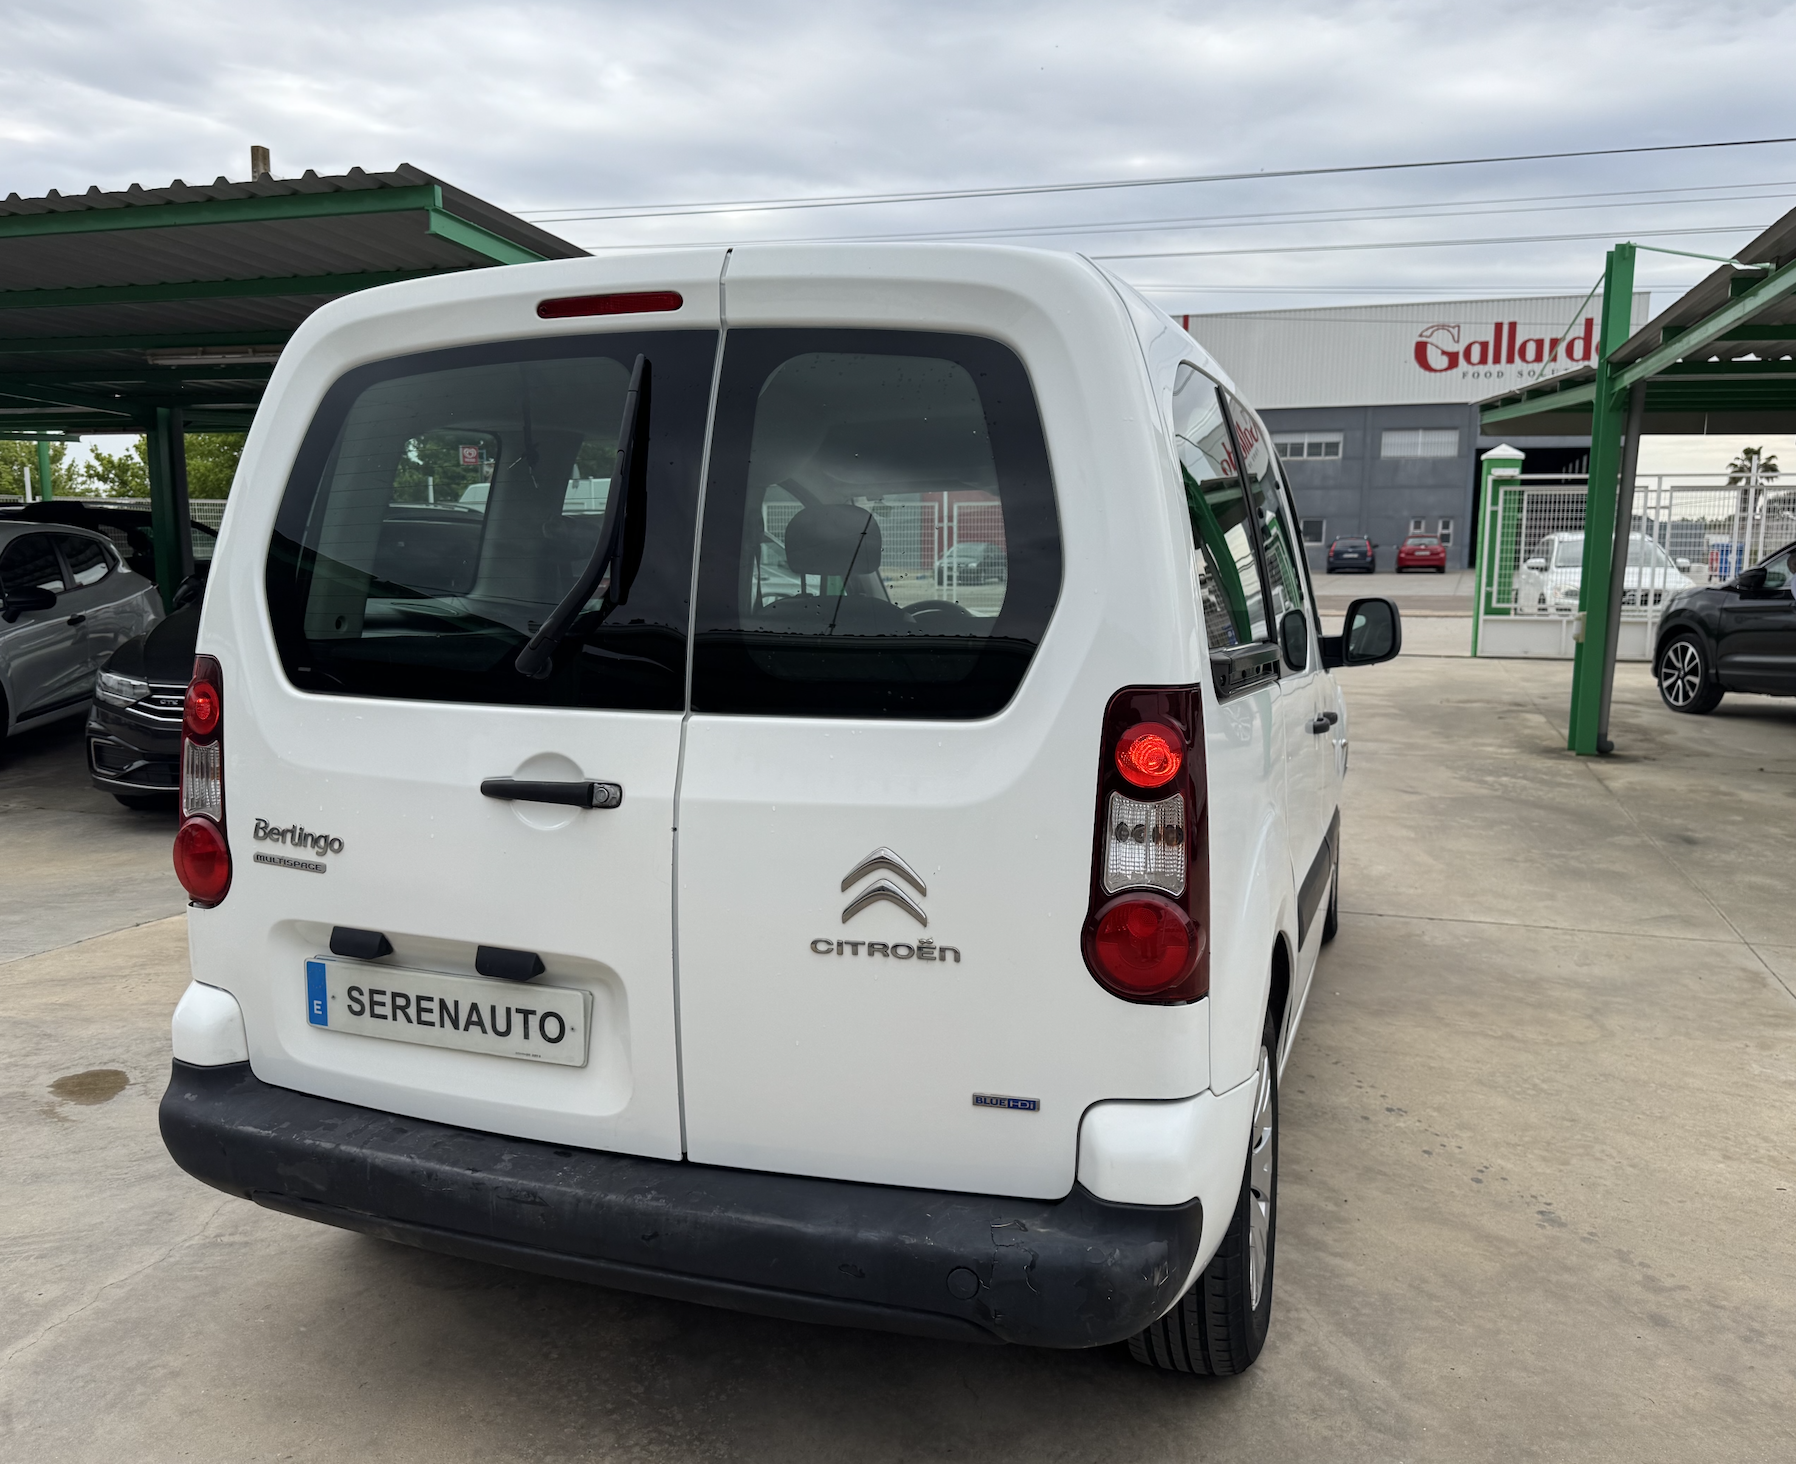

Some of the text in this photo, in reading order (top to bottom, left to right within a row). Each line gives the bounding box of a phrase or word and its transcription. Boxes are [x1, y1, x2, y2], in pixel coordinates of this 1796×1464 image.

[1414, 318, 1599, 373] Gallard
[1462, 370, 1504, 379] FOOD
[253, 817, 344, 857] Berlingo
[256, 854, 322, 872] MULTISPACE
[313, 985, 566, 1044] E SERENAUTO
